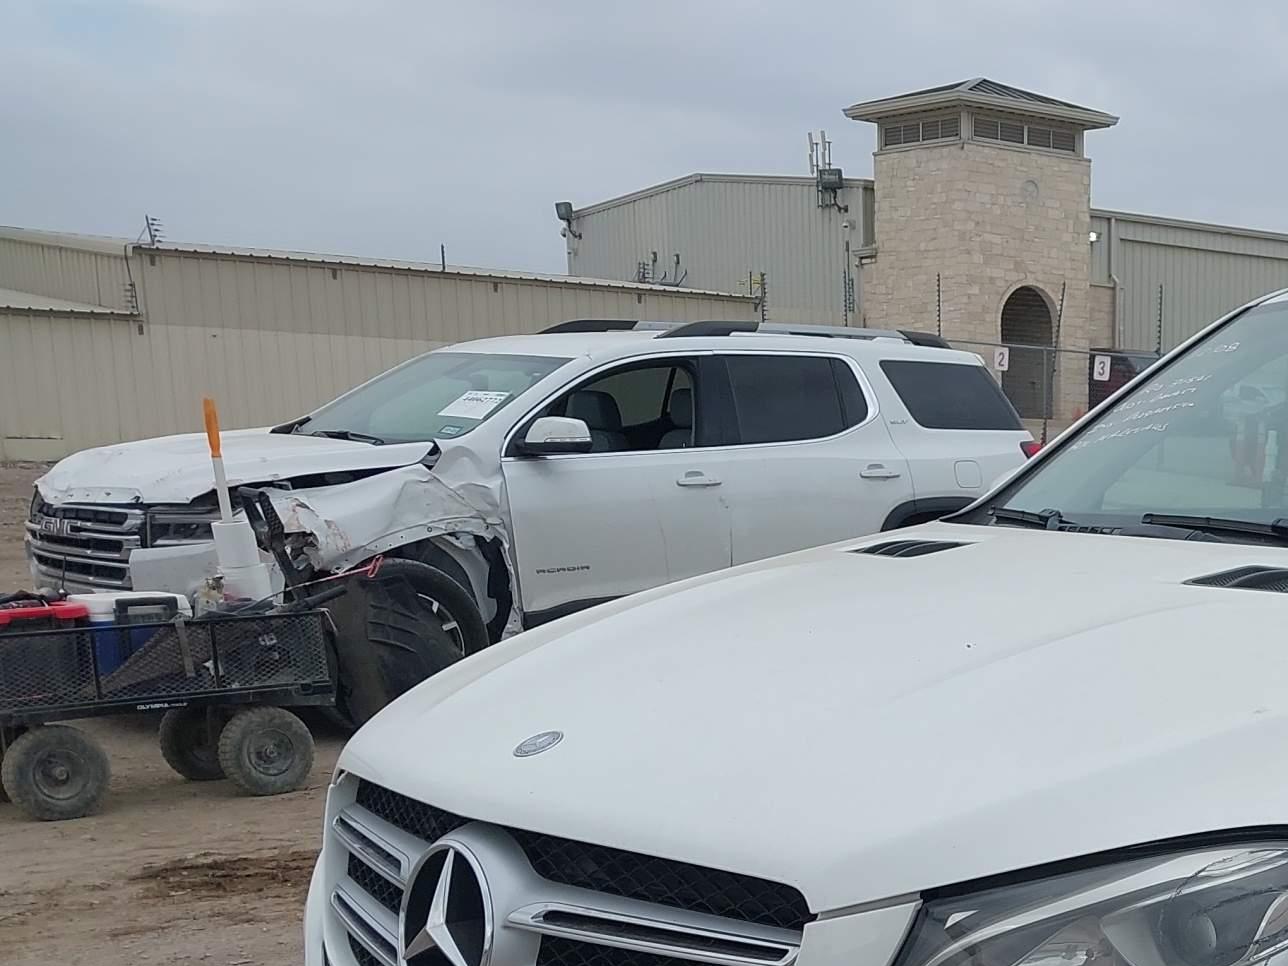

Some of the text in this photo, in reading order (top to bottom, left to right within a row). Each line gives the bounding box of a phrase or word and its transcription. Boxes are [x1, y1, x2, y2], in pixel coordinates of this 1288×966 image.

[998, 351, 1005, 367] 2
[1097, 360, 1106, 376] 3
[40, 516, 81, 534] GMC
